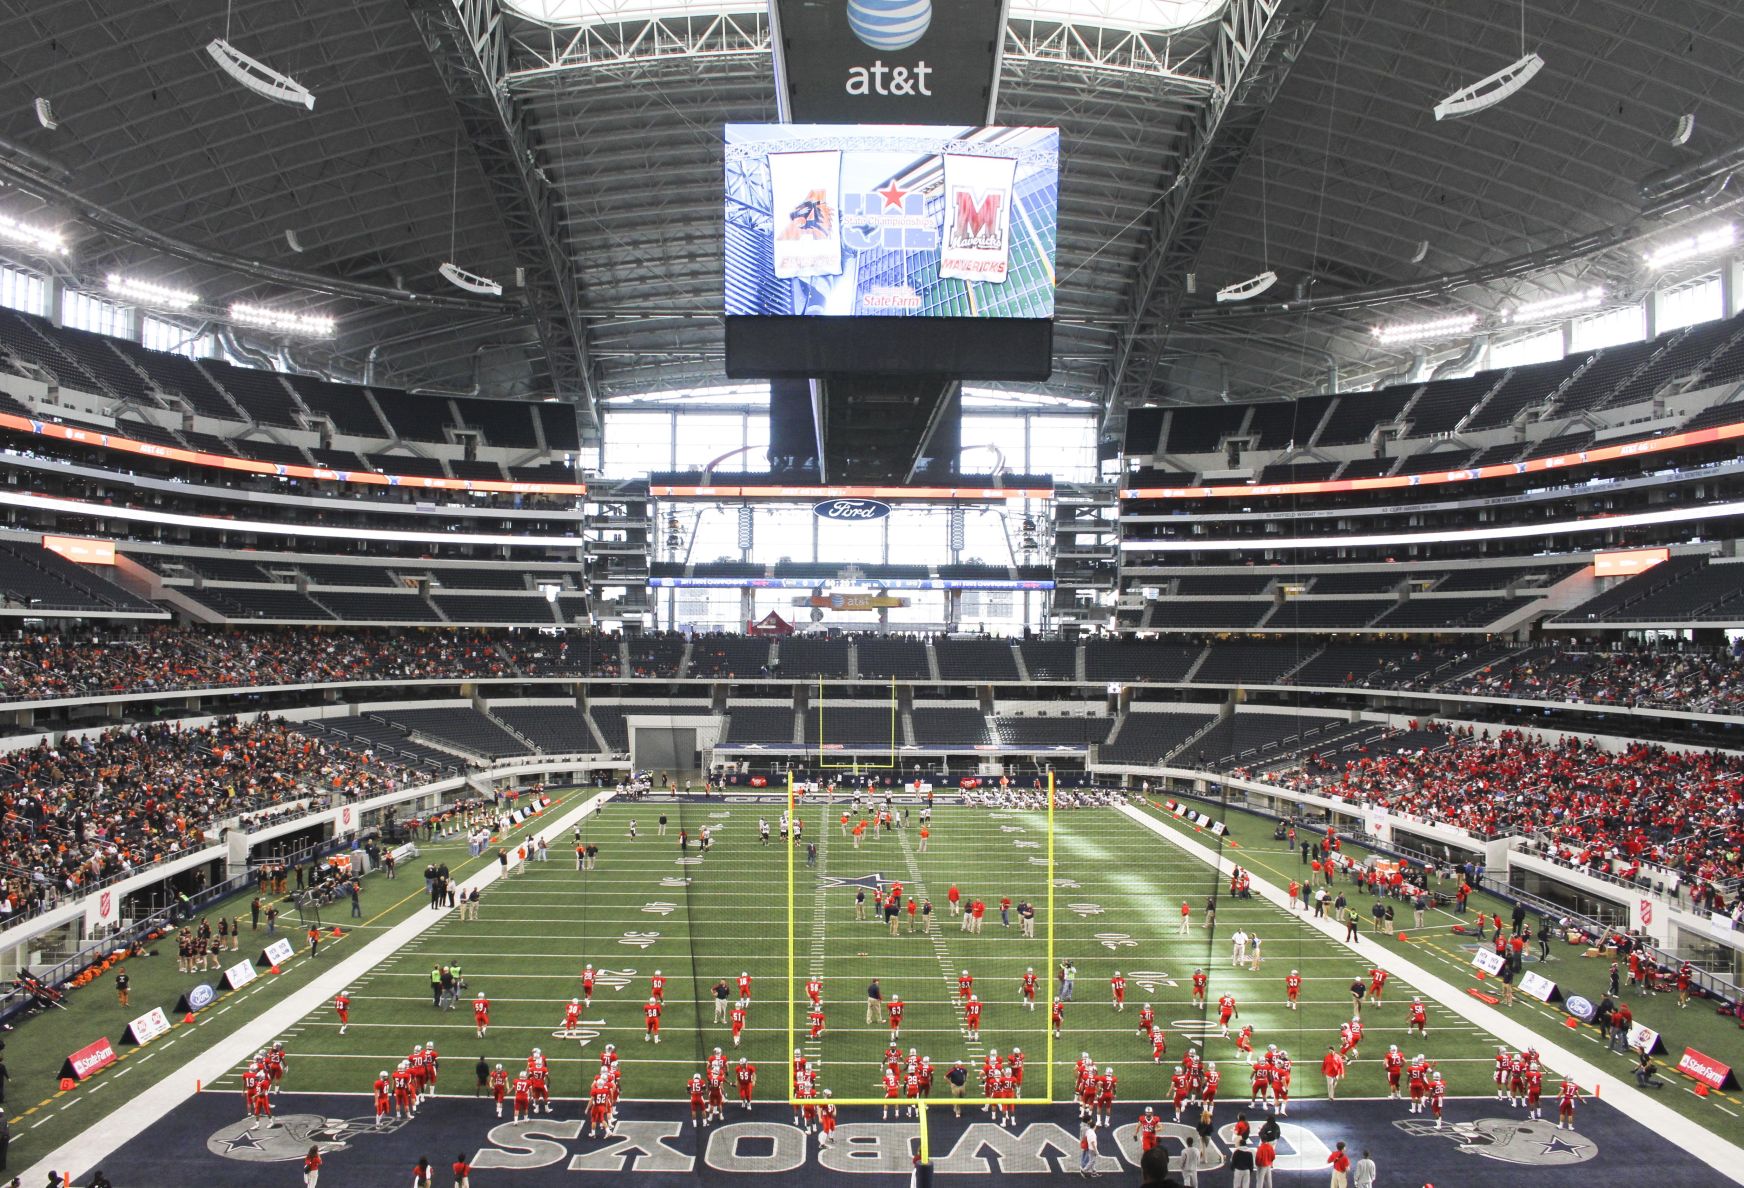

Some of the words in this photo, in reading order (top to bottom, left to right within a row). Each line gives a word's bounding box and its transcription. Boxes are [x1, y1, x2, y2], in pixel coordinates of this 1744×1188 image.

[846, 61, 932, 96] at&t
[844, 216, 865, 225] State
[865, 216, 934, 226] Championships
[948, 232, 1002, 250] Mavericks
[942, 258, 1006, 272] MAVERICKS
[829, 501, 876, 517] Ford
[413, 1057, 422, 1066] 70
[534, 1071, 543, 1079] 57
[740, 1072, 748, 1080] 55
[246, 1078, 255, 1087] 19
[516, 1082, 527, 1091] 67
[1004, 1080, 1012, 1089] 31
[1107, 1081, 1112, 1089] 7
[1180, 1079, 1184, 1088] 3
[692, 1083, 700, 1092] 15
[1566, 1087, 1574, 1095] 17
[596, 1094, 606, 1104] 52
[470, 1119, 1331, 1174] COWBOYS
